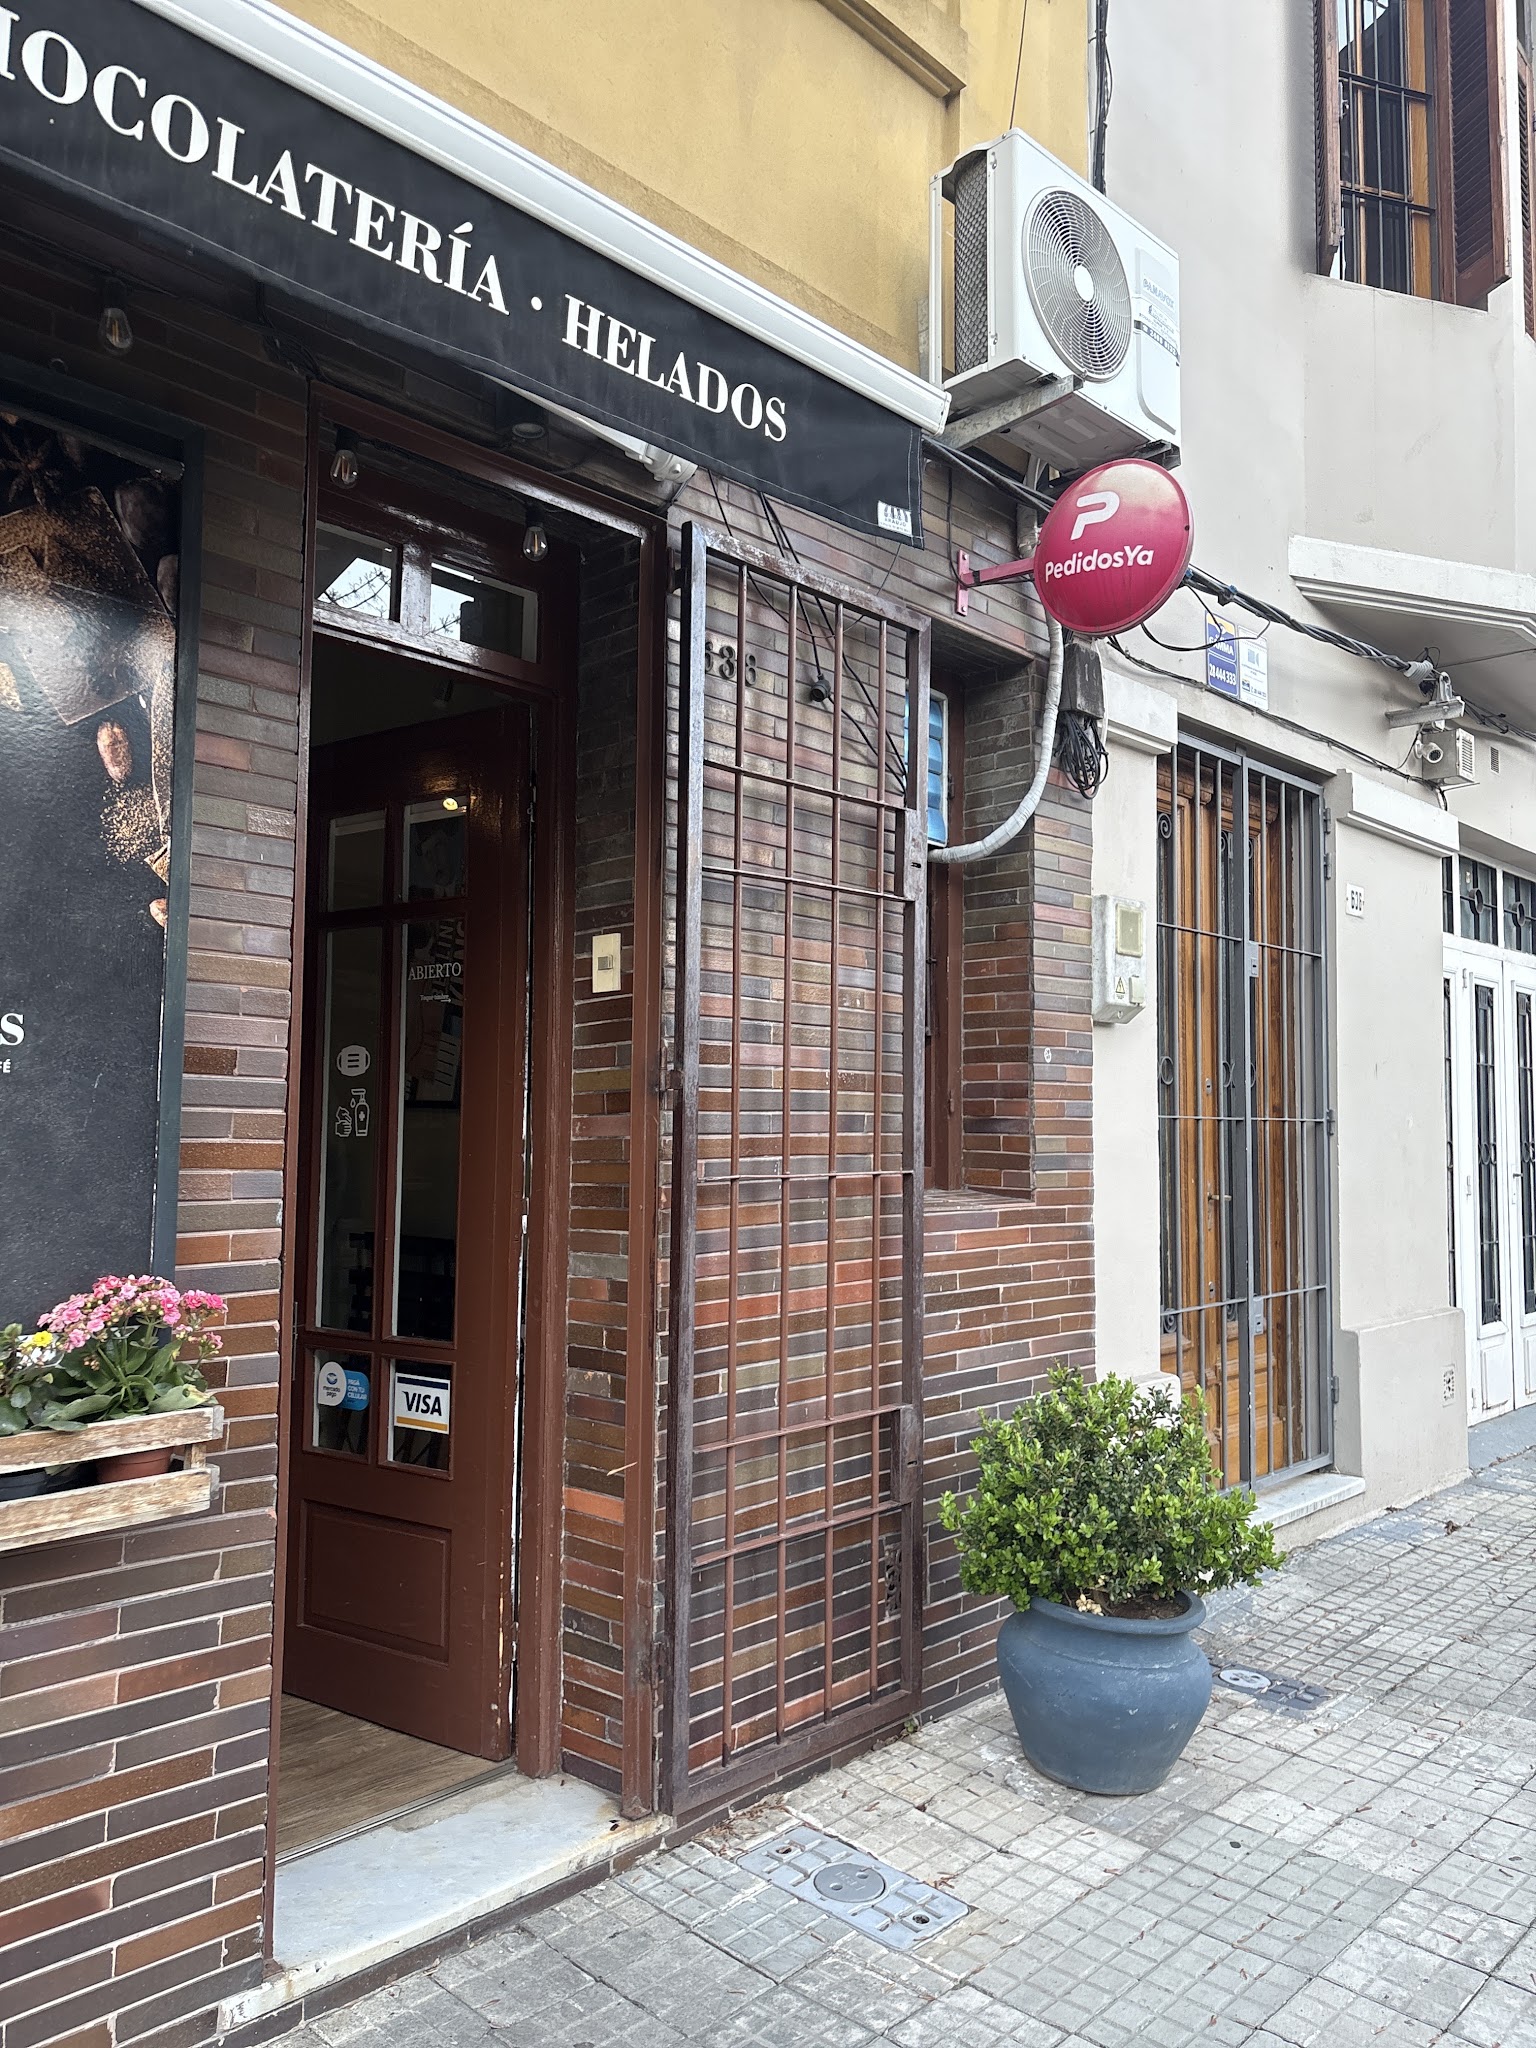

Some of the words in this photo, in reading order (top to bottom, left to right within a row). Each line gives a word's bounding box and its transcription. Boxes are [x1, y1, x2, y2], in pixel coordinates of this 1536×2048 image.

[561, 293, 788, 442] HELADOS
[1045, 545, 1155, 583] PedidosYa
[408, 962, 462, 980] ABIERTO
[402, 1391, 443, 1417] VISA
